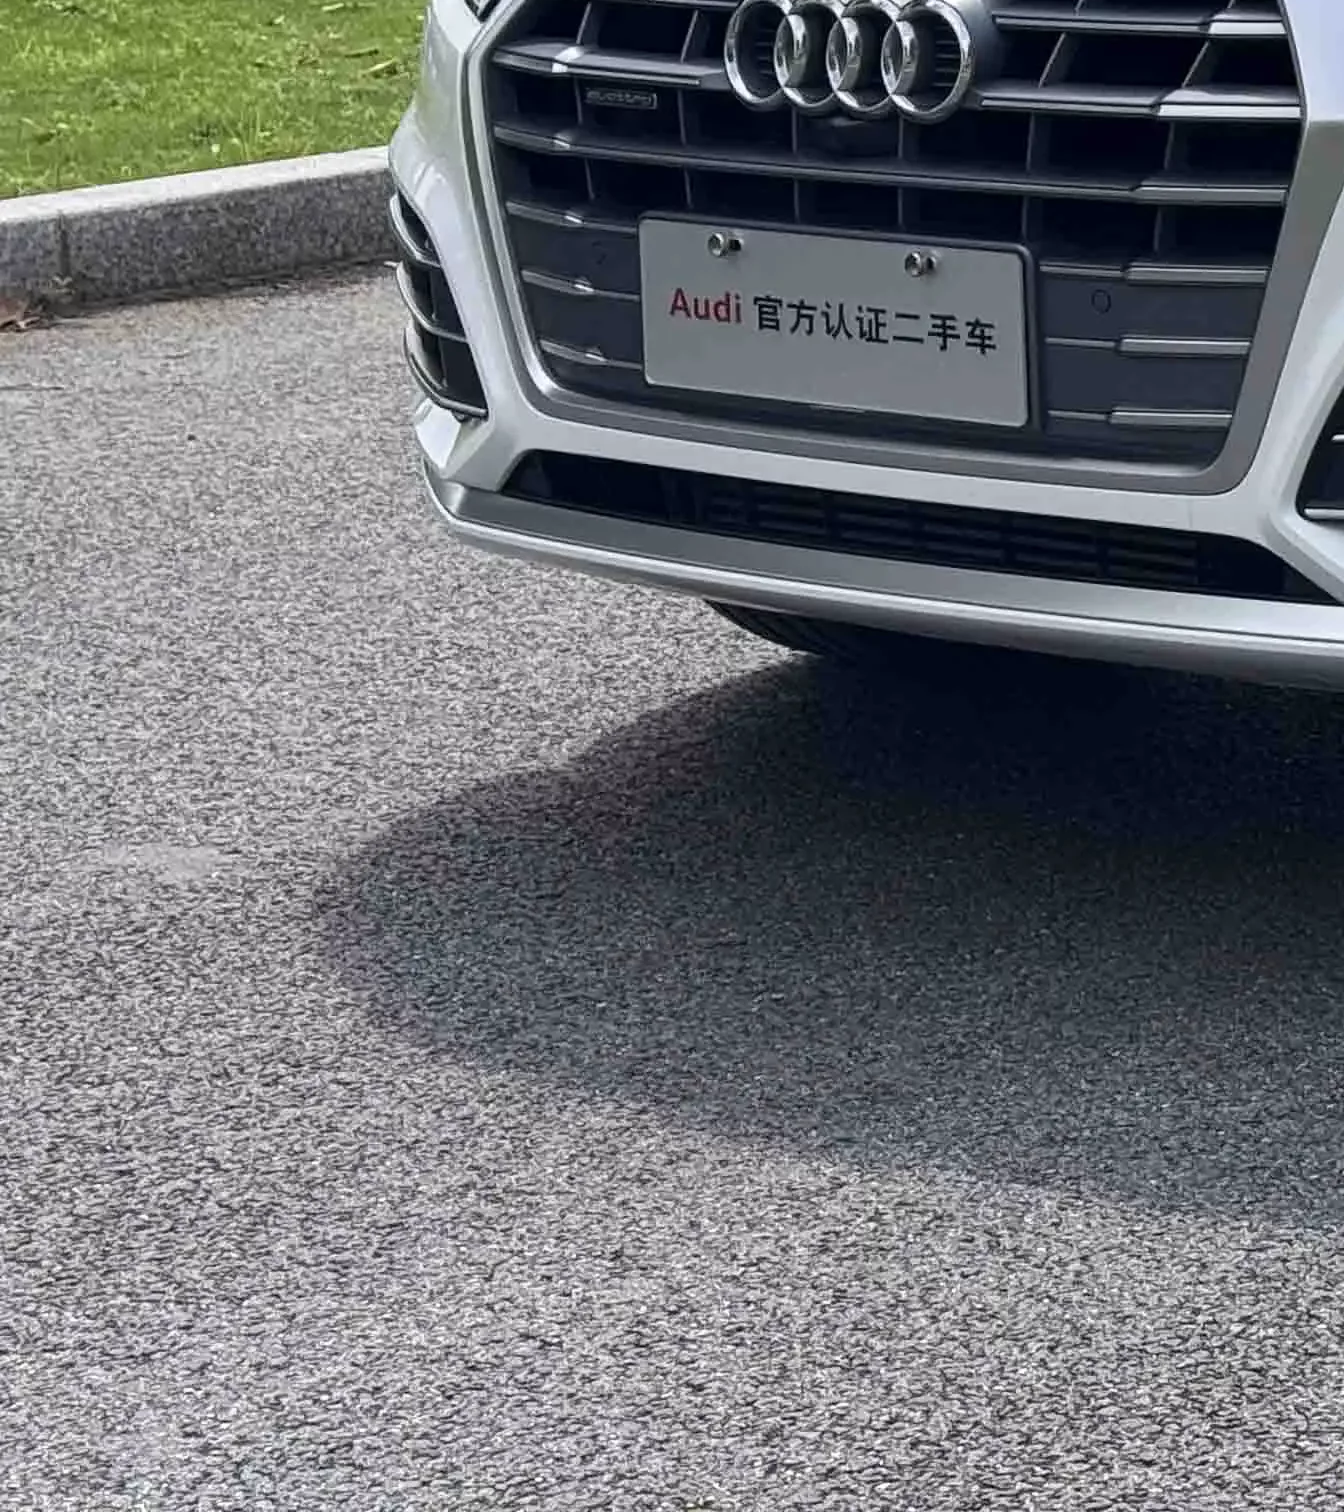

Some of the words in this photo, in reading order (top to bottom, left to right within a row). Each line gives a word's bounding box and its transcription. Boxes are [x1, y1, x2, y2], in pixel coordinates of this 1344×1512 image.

[669, 287, 743, 325] Audi
[753, 295, 997, 356] 官方认证二手车
